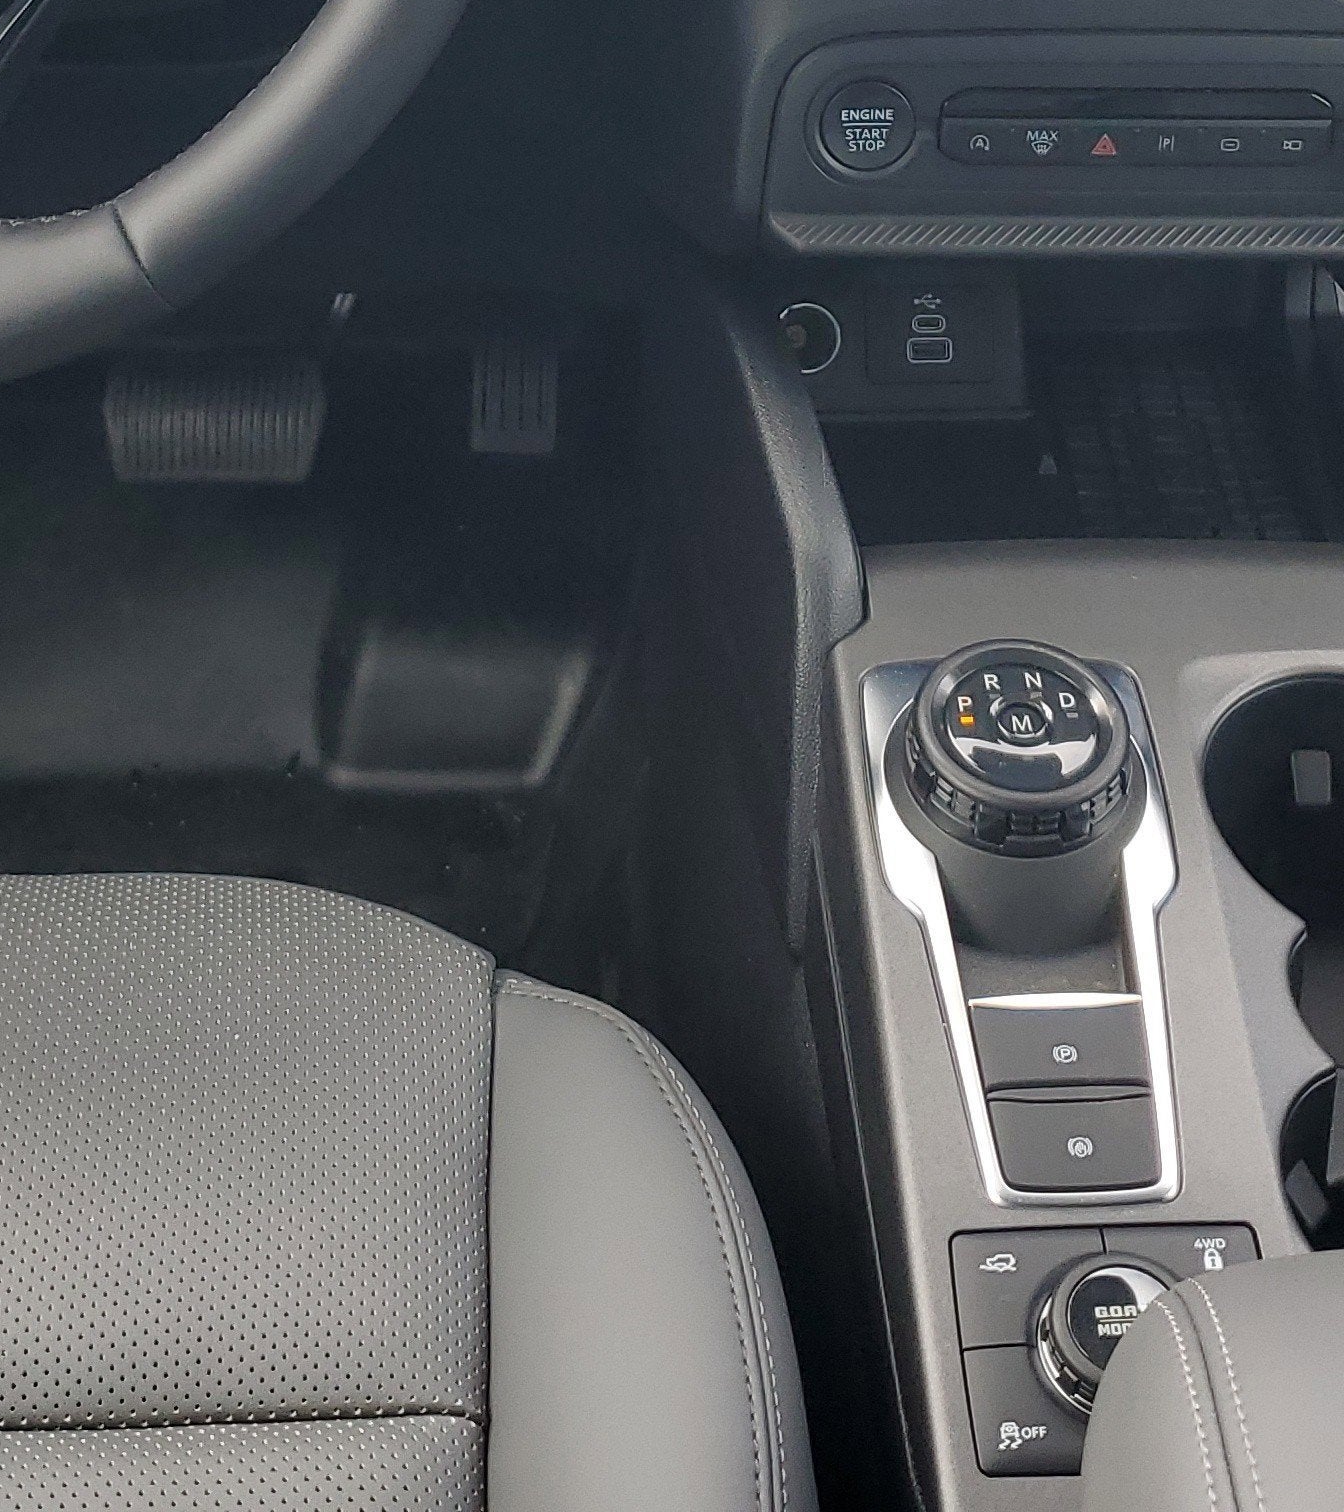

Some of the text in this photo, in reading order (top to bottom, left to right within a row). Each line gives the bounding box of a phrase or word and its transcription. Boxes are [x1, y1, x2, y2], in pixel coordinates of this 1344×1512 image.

[840, 108, 895, 121] ENGINE
[845, 128, 889, 140] START
[1026, 130, 1059, 142] MAX
[848, 140, 886, 152] STOP
[983, 673, 1002, 691] R
[1024, 672, 1043, 689] N
[958, 695, 973, 712] P
[1058, 691, 1075, 708] D
[1011, 715, 1033, 732] M
[1193, 1236, 1226, 1250] 4WD
[1021, 1426, 1047, 1440] OFF
